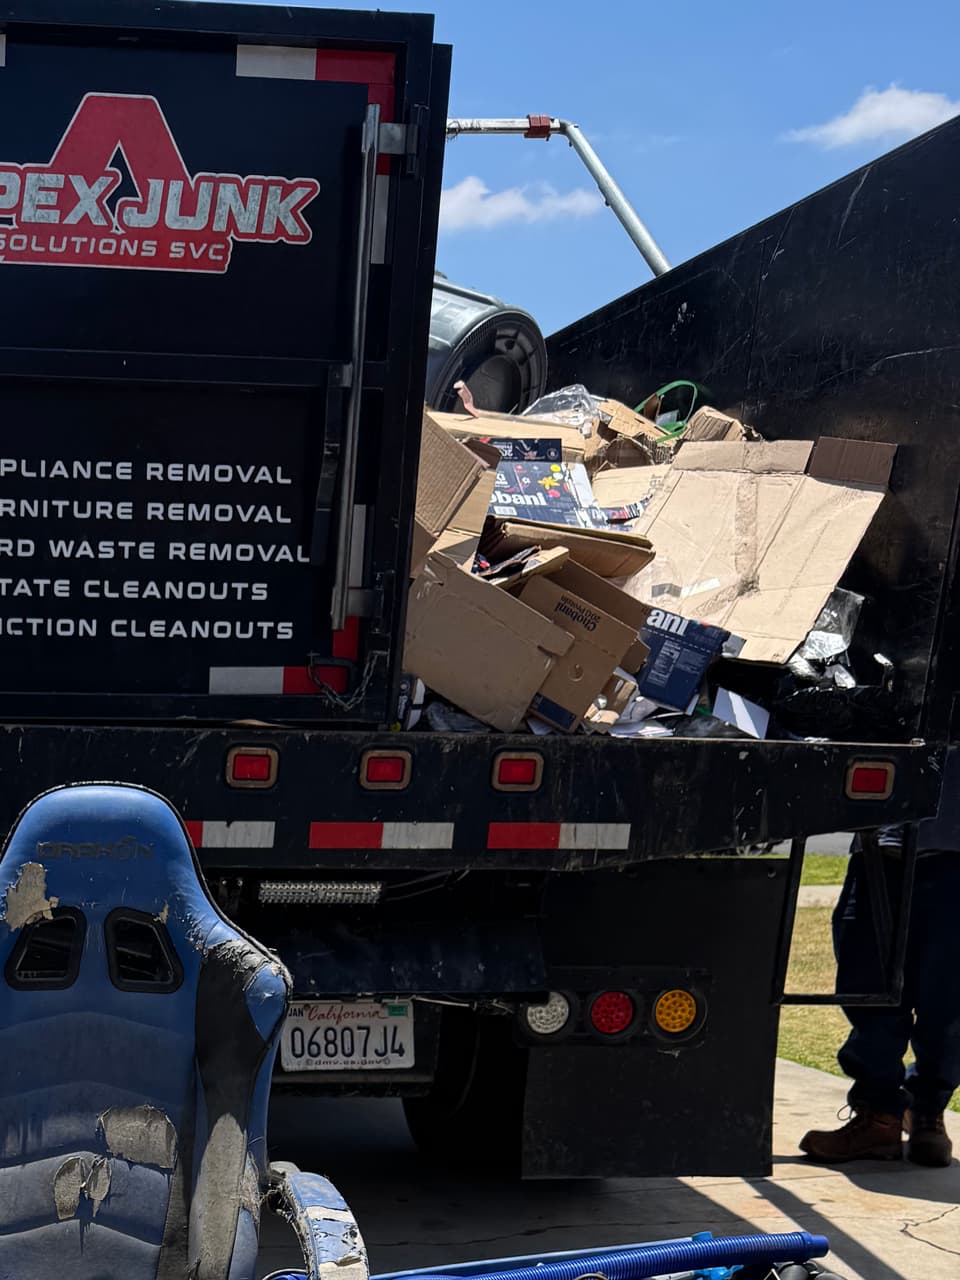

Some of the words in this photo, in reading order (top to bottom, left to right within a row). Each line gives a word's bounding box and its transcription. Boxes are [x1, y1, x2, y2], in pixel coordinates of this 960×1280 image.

[122, 177, 318, 237] JUNK
[169, 241, 226, 261] SVC
[146, 462, 292, 484] REMOVAL
[146, 502, 292, 524] REMOVAL
[49, 539, 156, 560] WASTE
[168, 542, 311, 563] REMOVAL
[83, 580, 268, 601] CLEANOUTS
[110, 619, 294, 640] CLEANOUTS
[288, 1007, 304, 1017] JAN
[306, 1004, 389, 1026] California
[290, 1025, 406, 1058] 06807J4
